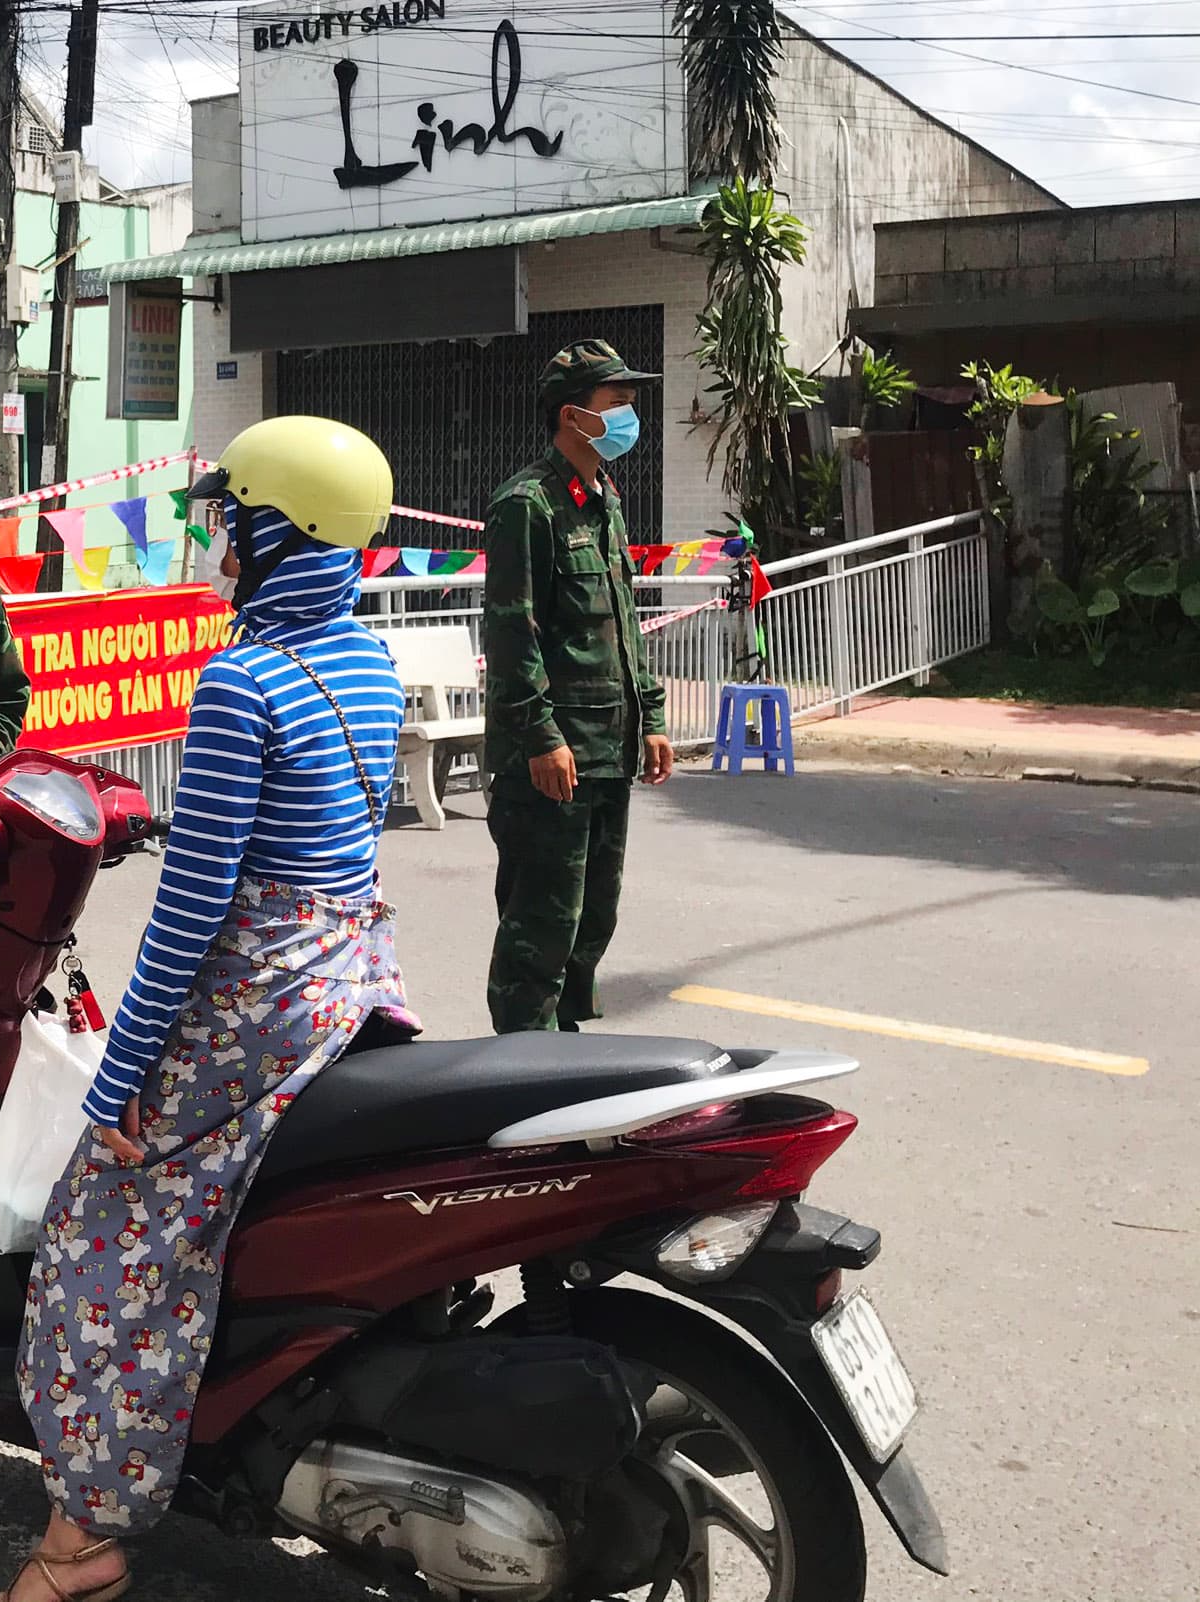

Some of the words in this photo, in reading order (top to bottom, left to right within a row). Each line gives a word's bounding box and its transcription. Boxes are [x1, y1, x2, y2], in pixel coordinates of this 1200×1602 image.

[253, 11, 354, 52] BEAUTY
[360, 0, 445, 33] SALON
[333, 19, 564, 190] Linh
[131, 303, 175, 334] LINH
[31, 630, 76, 674] TRA
[81, 613, 158, 668] NGƯỜI
[163, 617, 190, 657] RA
[25, 677, 113, 732] HƯỜNG
[118, 668, 162, 717] TÂN
[382, 1173, 592, 1216] VISION
